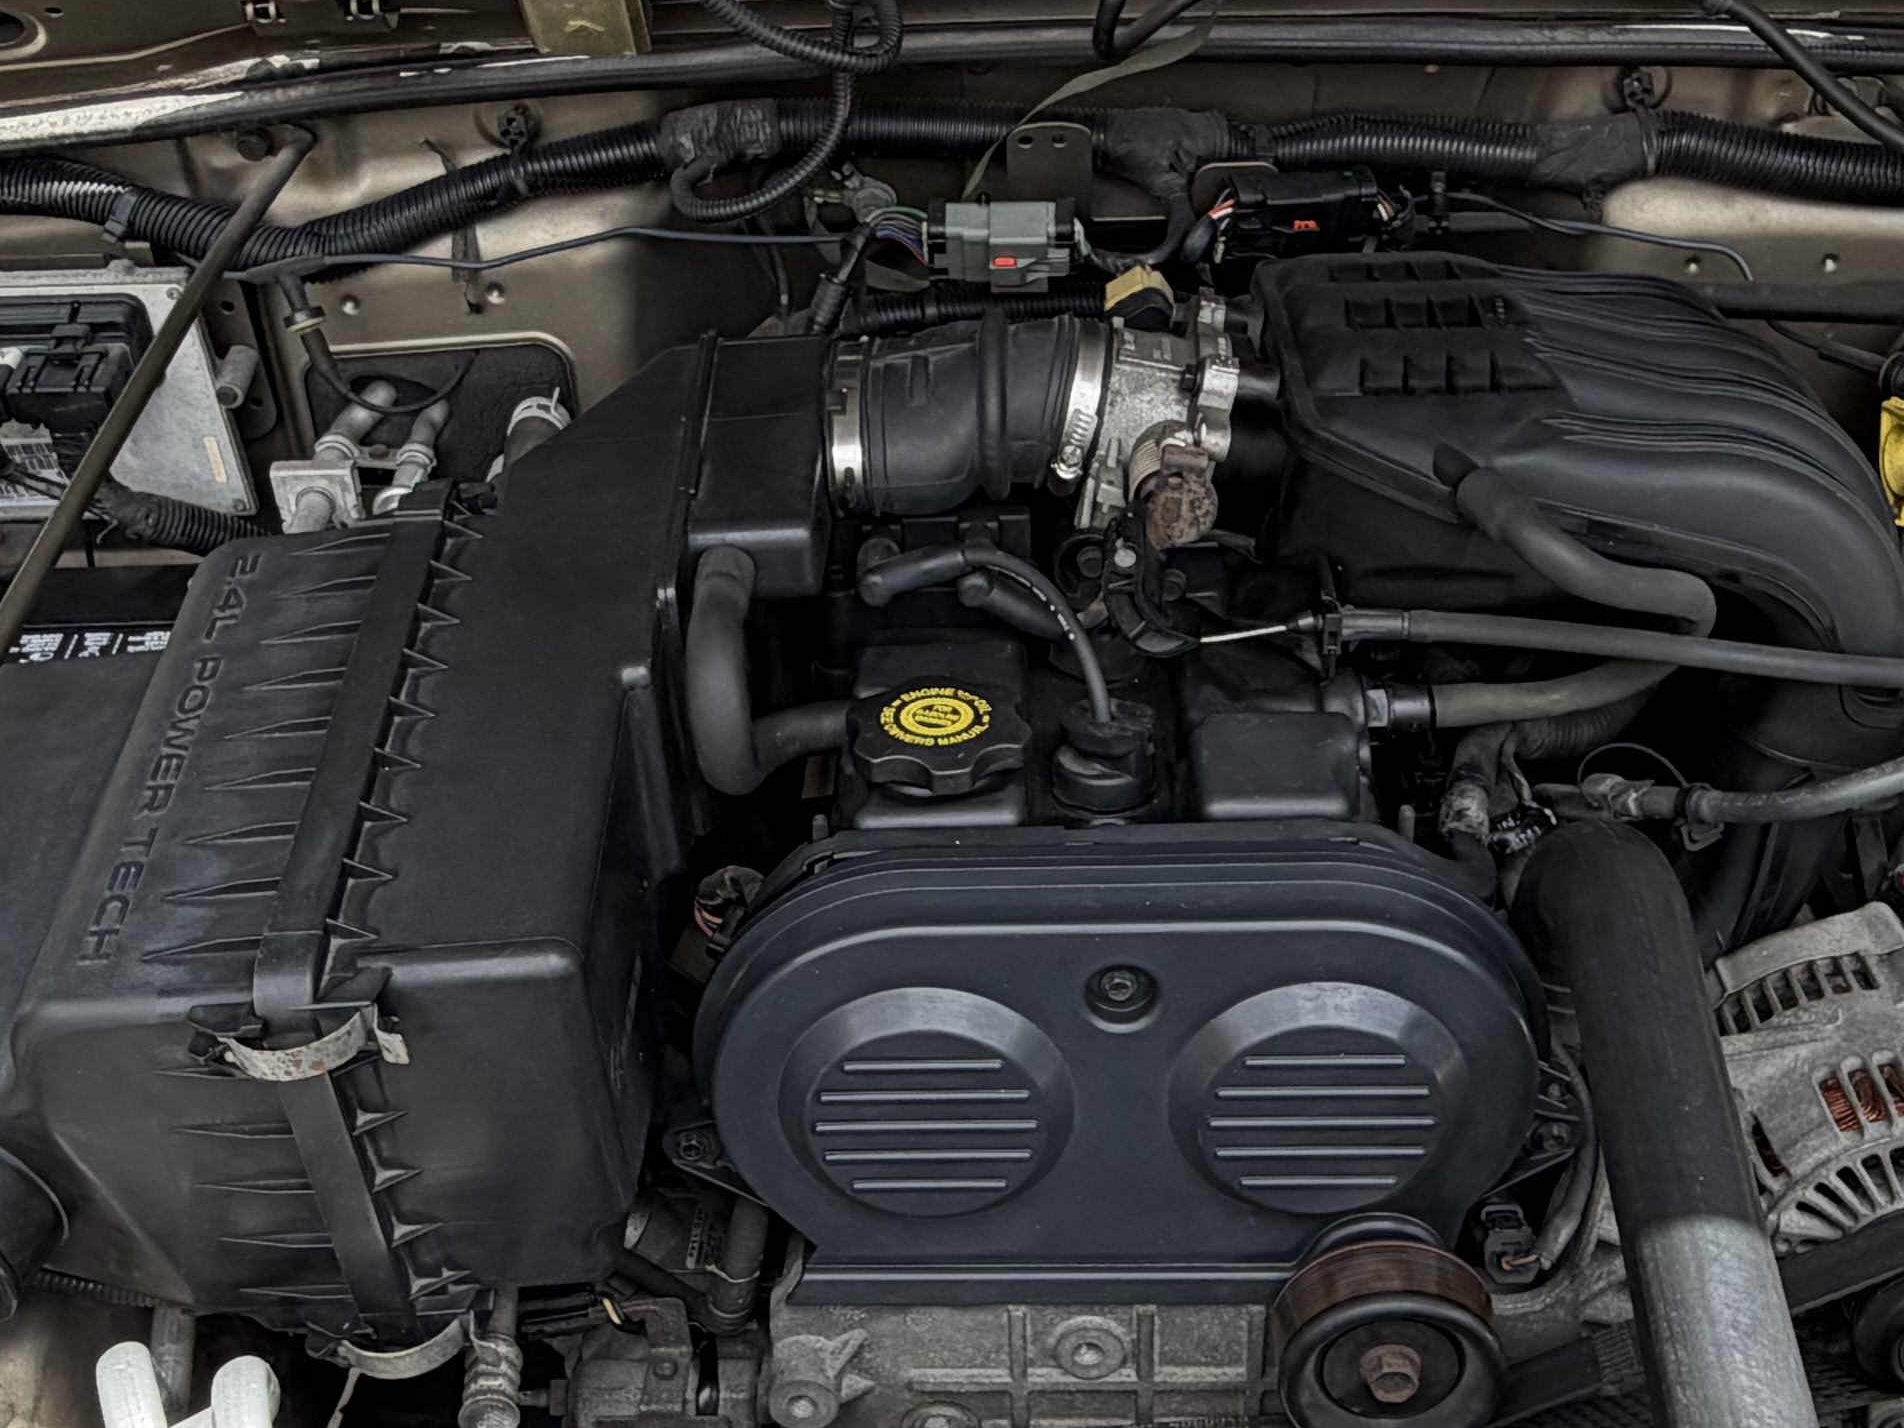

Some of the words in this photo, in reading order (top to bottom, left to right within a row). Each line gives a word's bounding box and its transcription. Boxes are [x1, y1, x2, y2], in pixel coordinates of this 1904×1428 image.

[204, 551, 262, 642] 2.4L
[134, 656, 220, 820] POWER
[884, 724, 935, 746] OWNERS
[938, 724, 989, 745] MANUAL
[901, 688, 955, 701] ENGINE
[77, 827, 160, 966] TECH
